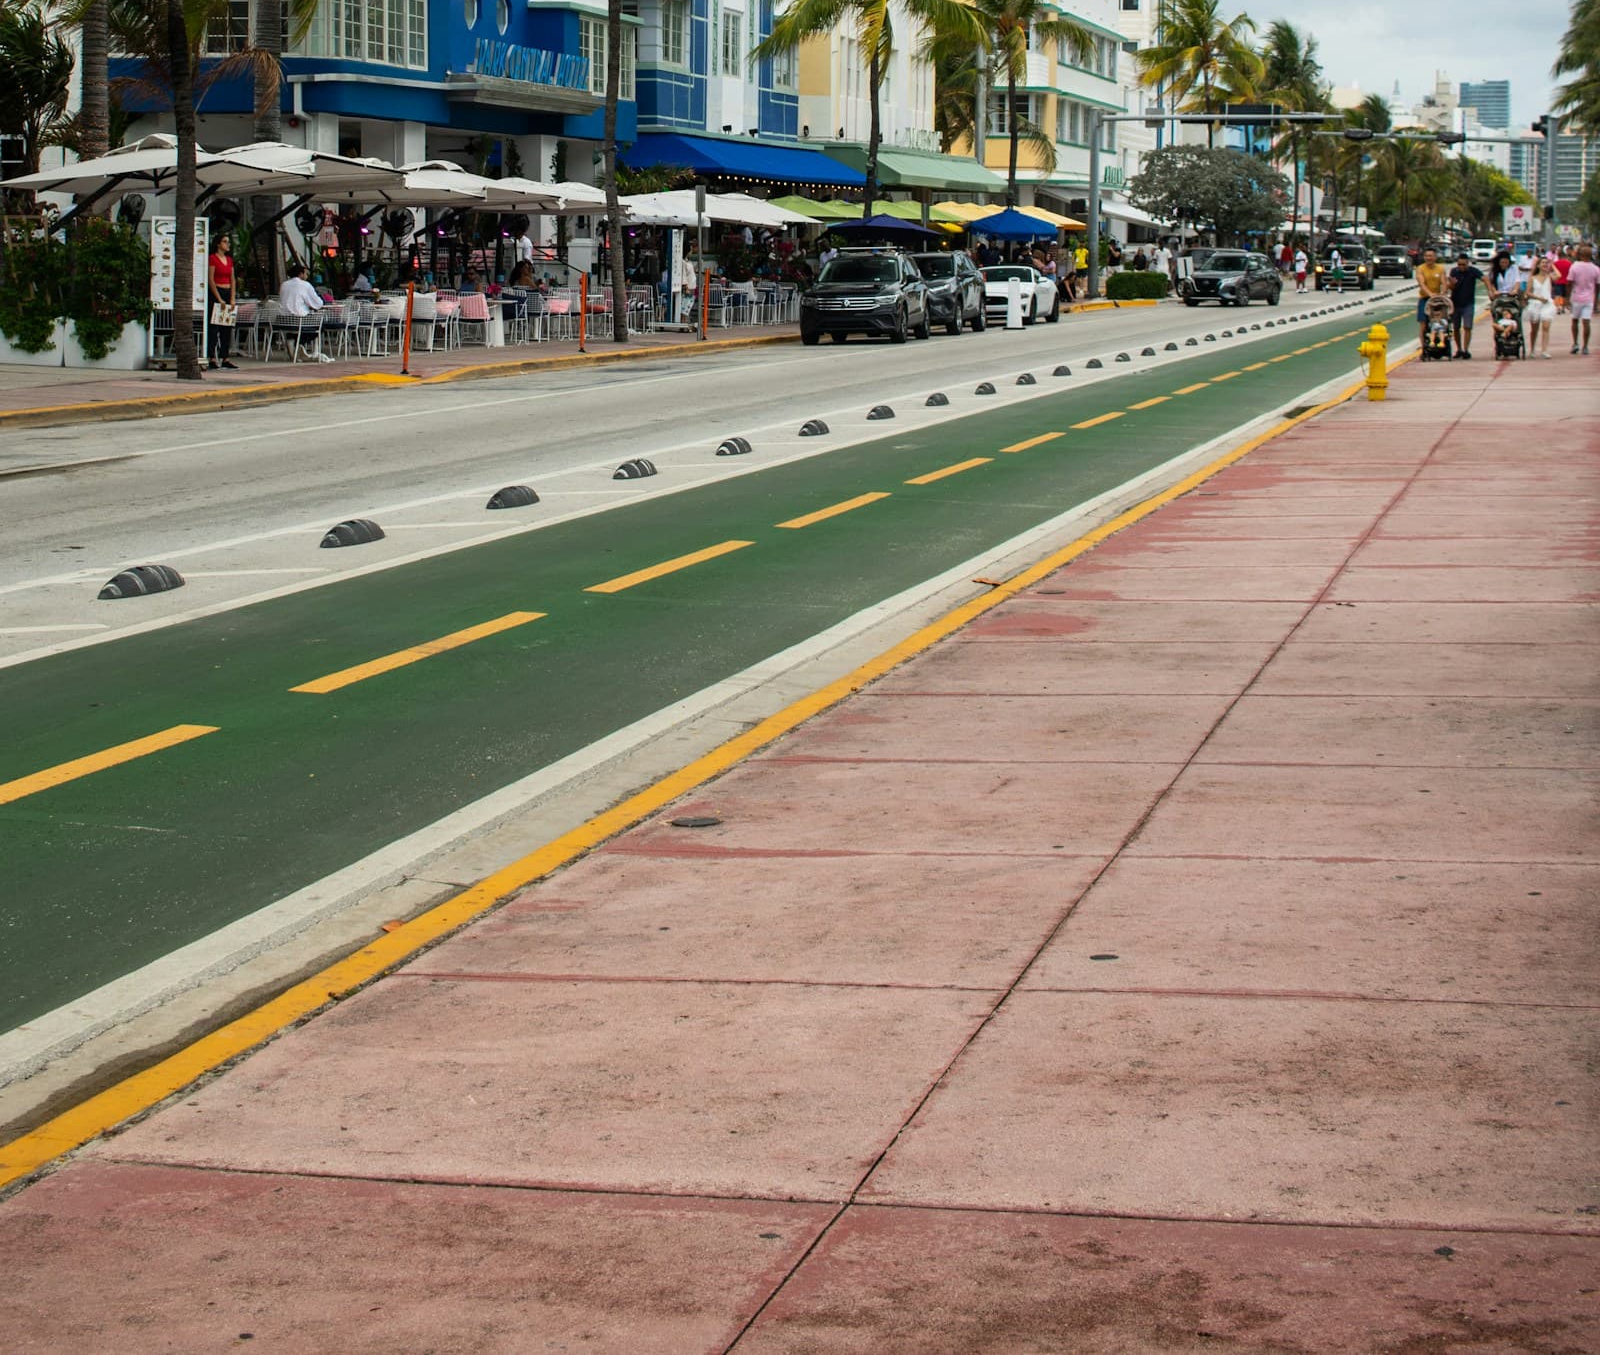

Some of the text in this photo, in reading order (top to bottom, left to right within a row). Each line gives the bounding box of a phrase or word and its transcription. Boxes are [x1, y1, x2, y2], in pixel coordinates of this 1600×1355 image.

[474, 38, 589, 90] PARK CENTRAL HOTEL
